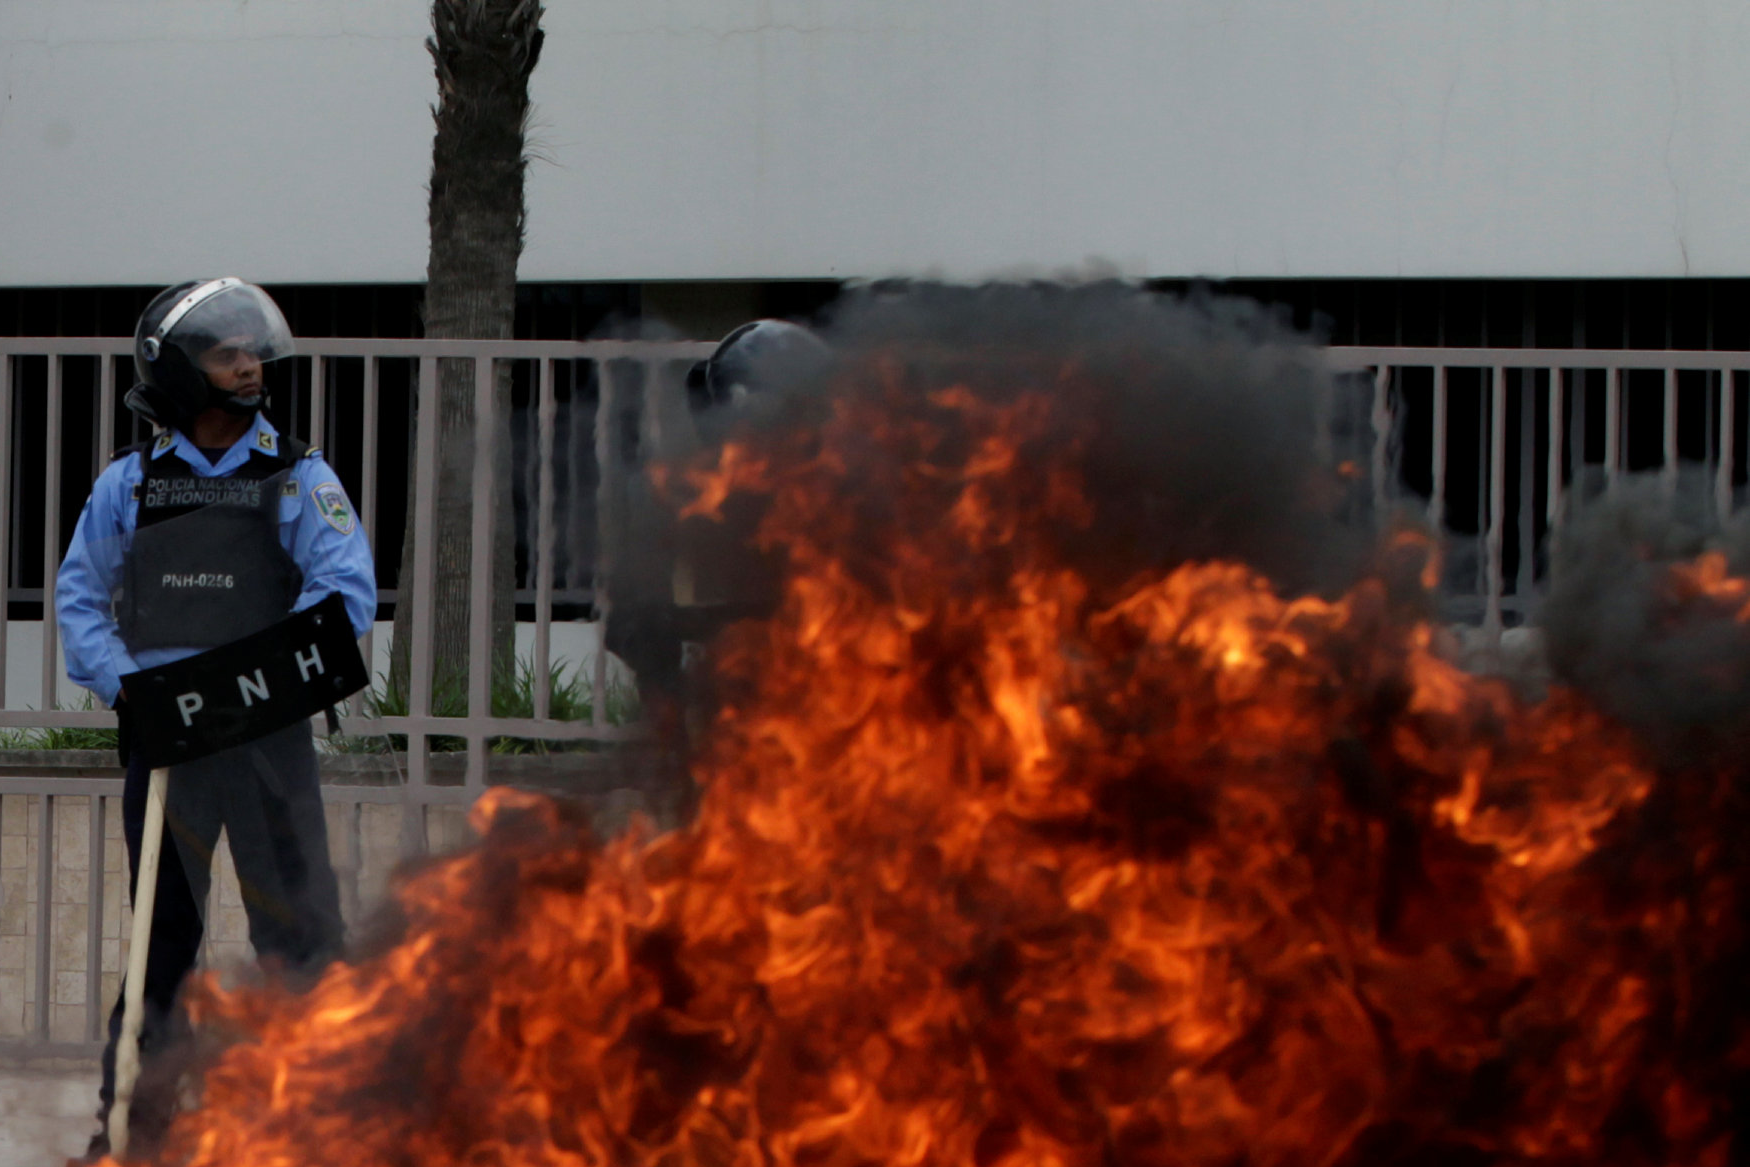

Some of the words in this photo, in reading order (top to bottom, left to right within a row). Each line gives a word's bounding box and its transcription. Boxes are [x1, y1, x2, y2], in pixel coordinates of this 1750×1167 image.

[147, 478, 195, 493] POLICIA
[197, 478, 261, 493] NACIONAL
[145, 493, 167, 508] DE
[170, 491, 261, 508] HONDURAS
